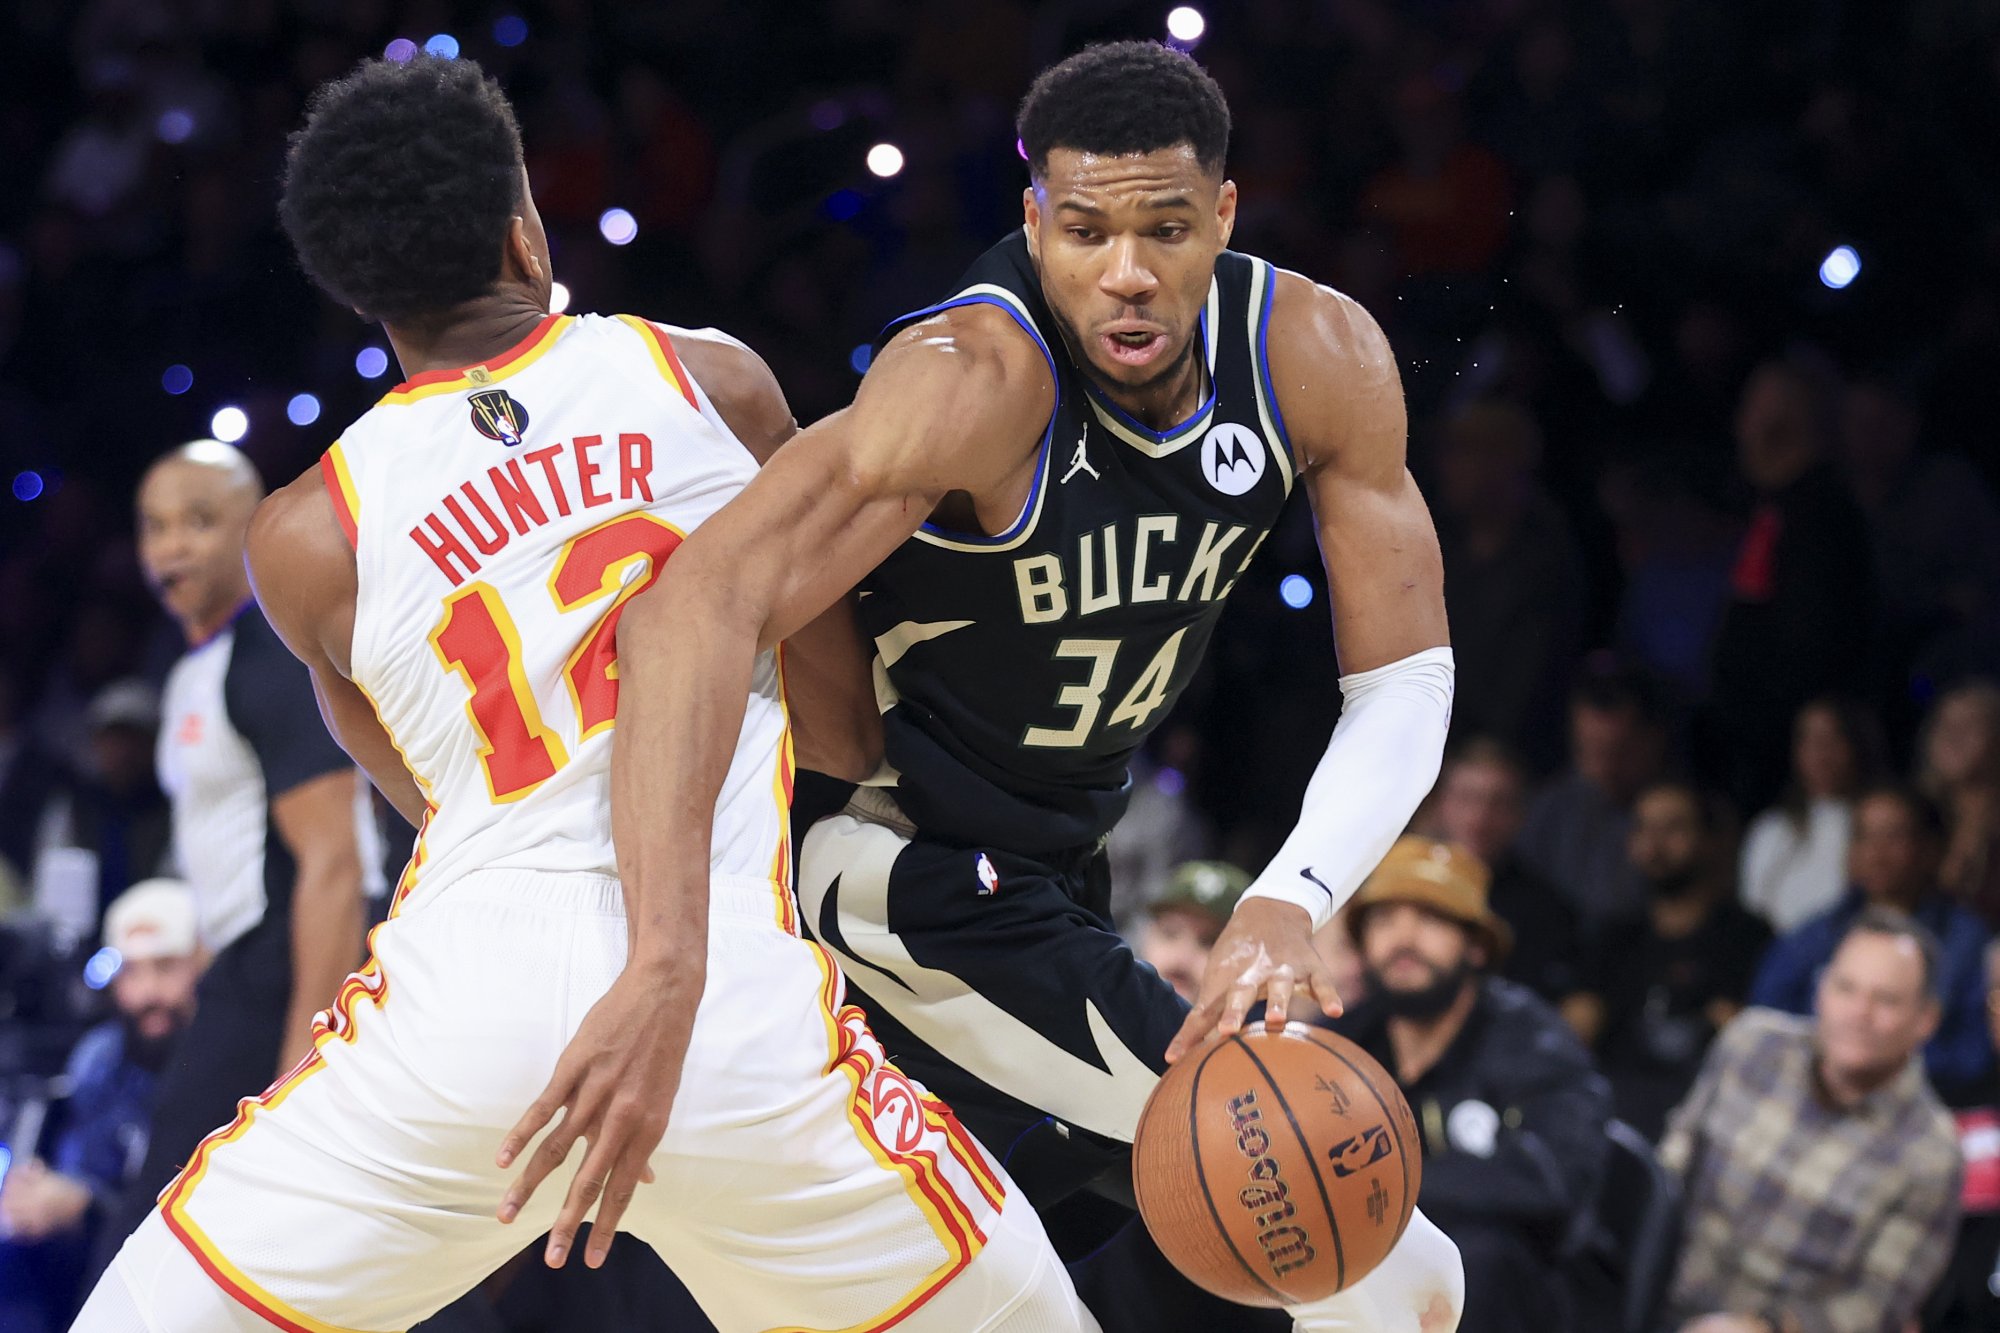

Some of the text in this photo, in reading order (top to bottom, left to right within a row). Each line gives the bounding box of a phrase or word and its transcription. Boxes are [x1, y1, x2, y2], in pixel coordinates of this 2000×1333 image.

[409, 433, 653, 587] HUNTER
[427, 510, 688, 806] 12
[1022, 628, 1190, 747] 34
[1225, 1089, 1316, 1280] Wilson
